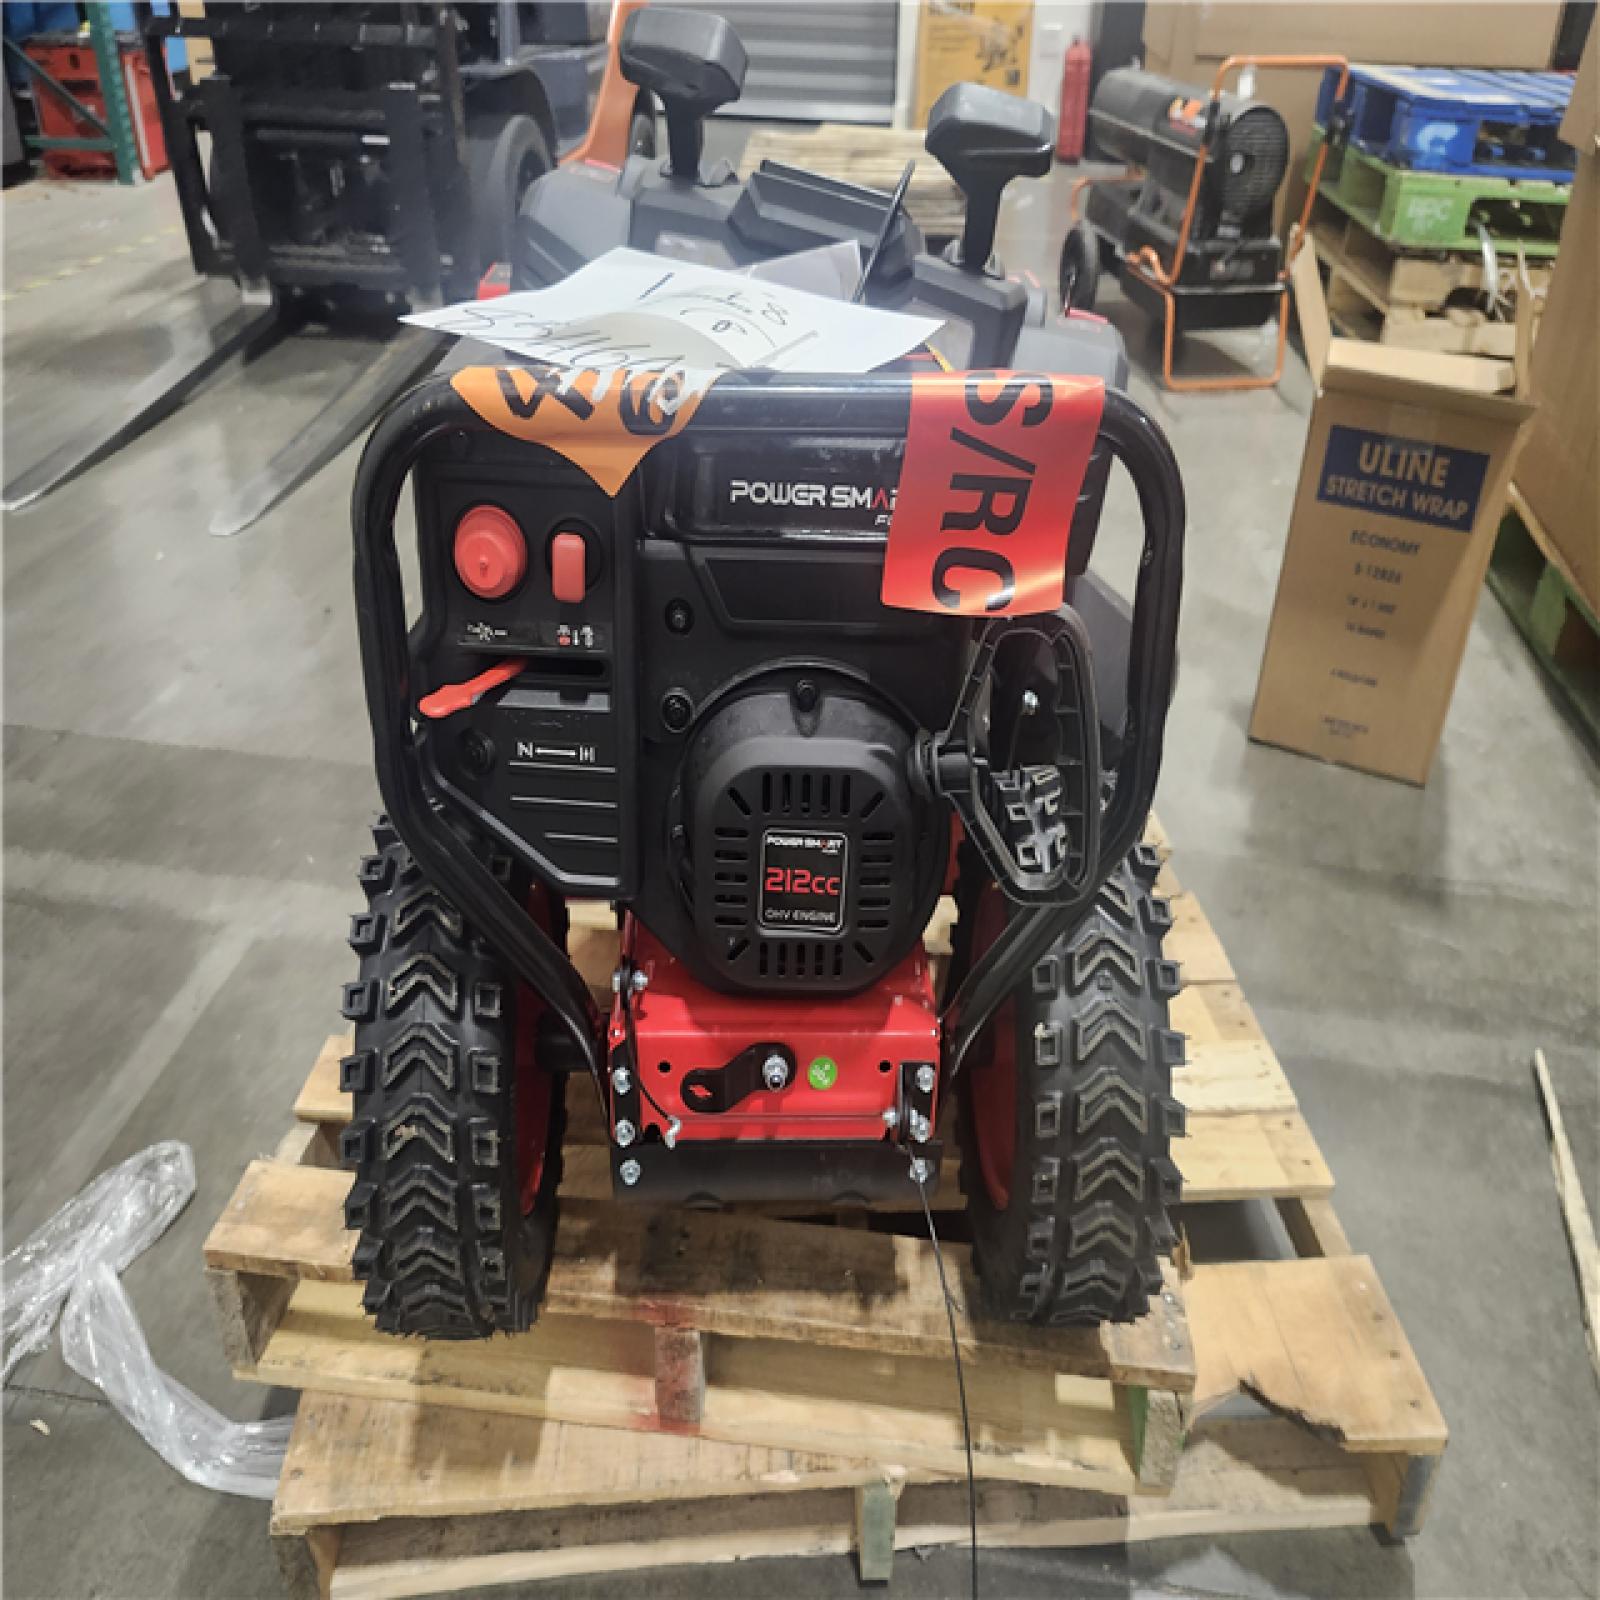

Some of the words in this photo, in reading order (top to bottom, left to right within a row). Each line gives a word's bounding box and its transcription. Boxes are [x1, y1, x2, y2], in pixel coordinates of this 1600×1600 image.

[1358, 439, 1450, 489] ULINE
[729, 479, 826, 507] POWER
[932, 372, 1054, 612] S/RC
[1326, 475, 1409, 509] STRETCH
[1412, 490, 1469, 521] WRAP
[1350, 529, 1421, 555] ECONOMY
[764, 865, 841, 896] 212cc
